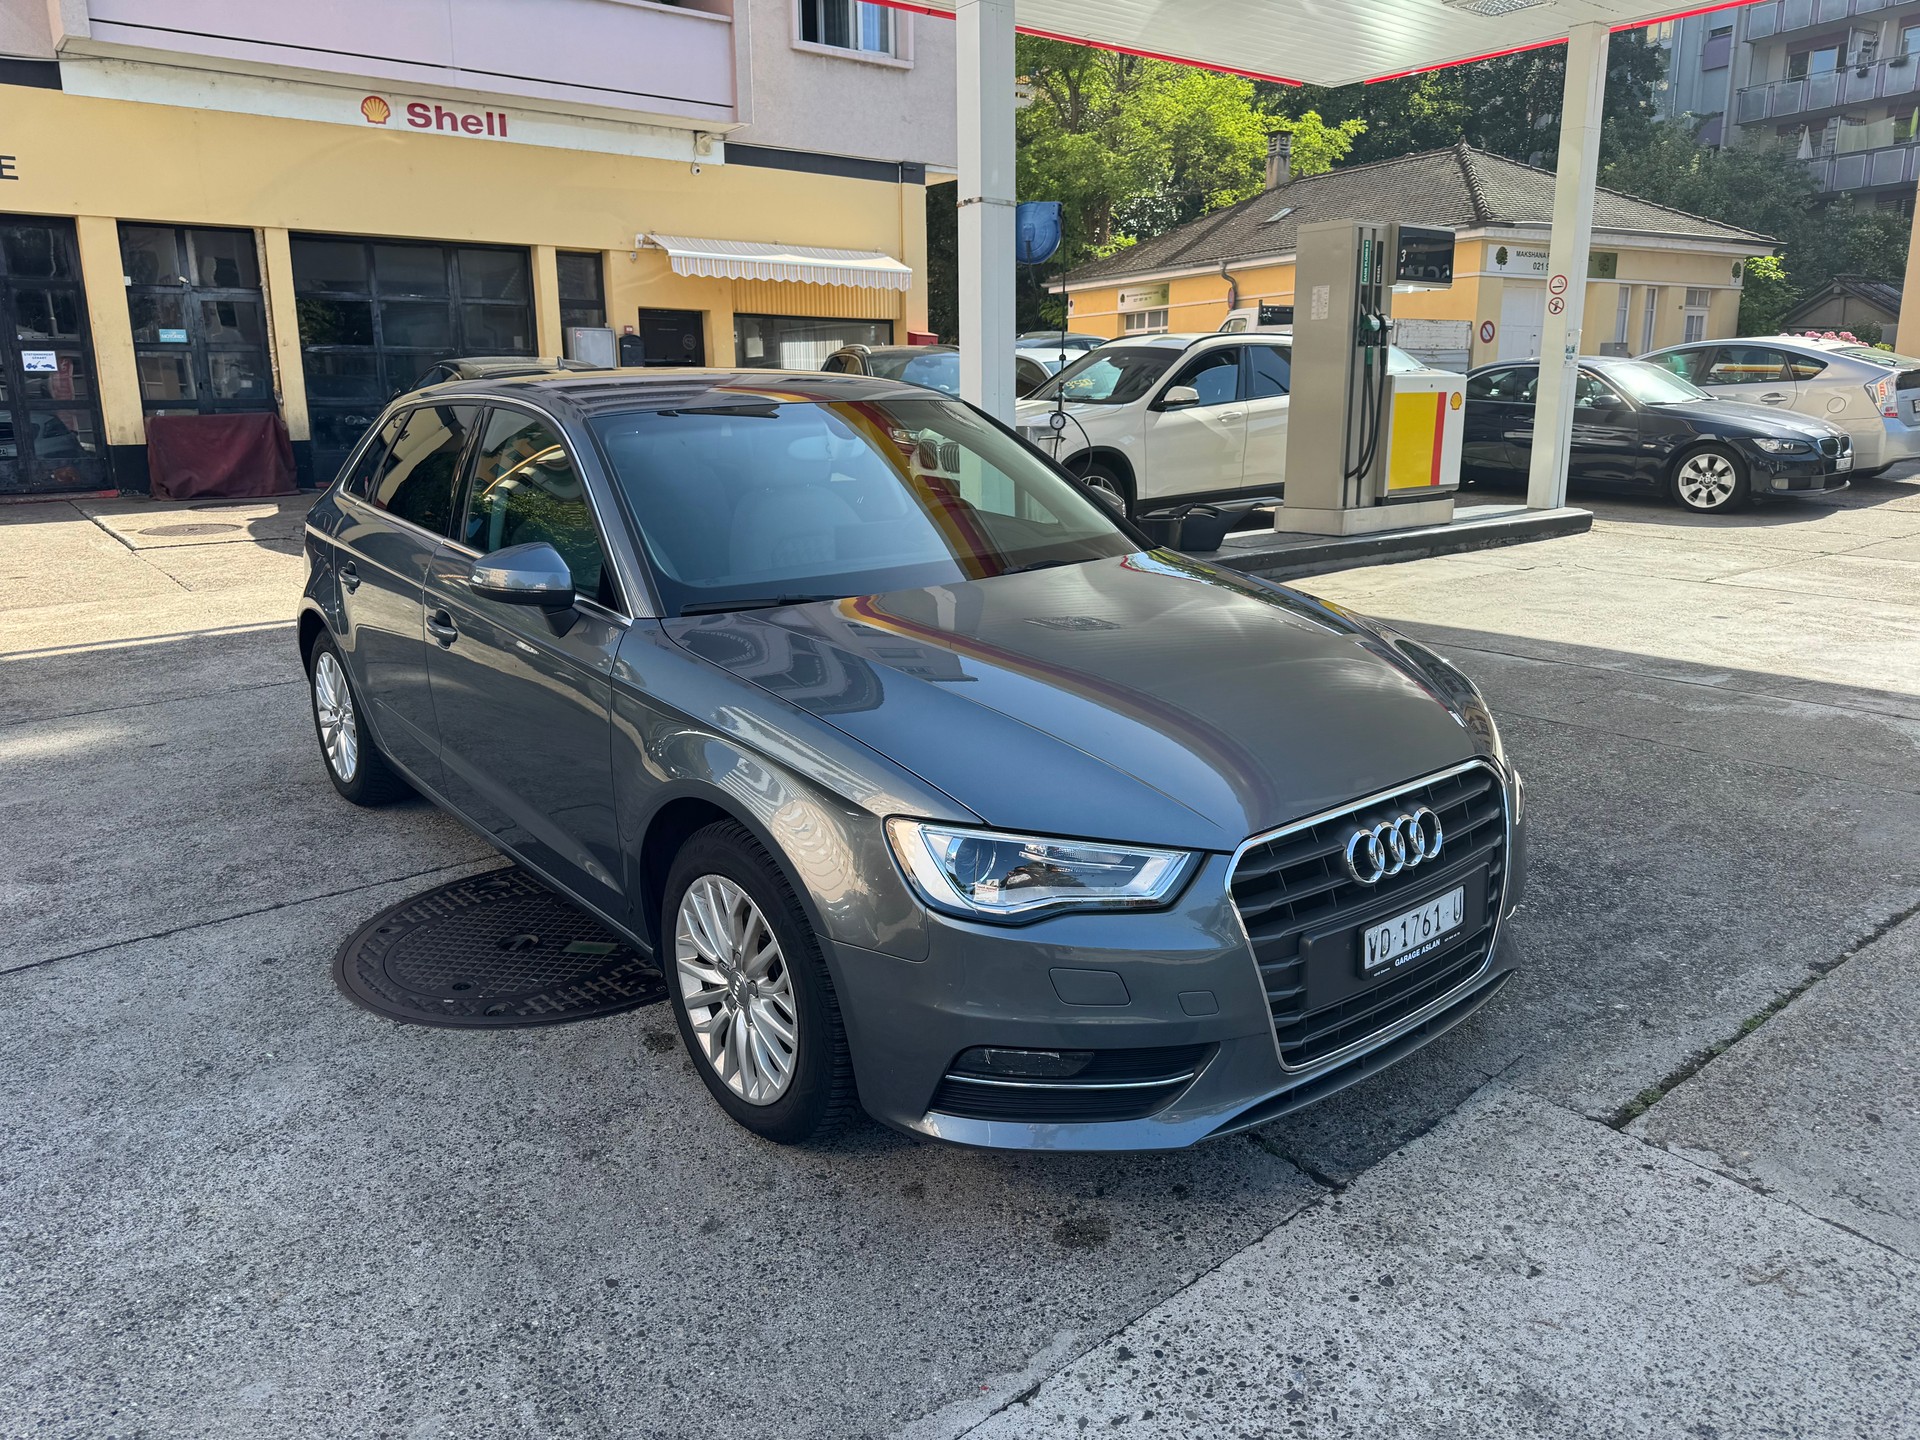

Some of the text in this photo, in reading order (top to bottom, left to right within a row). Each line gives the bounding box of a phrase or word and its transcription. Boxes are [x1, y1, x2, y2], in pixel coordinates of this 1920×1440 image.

[406, 102, 508, 138] Shell
[1400, 249, 1407, 263] 3
[1516, 250, 1547, 259] MAKSHANA
[1532, 262, 1544, 271] 021
[1368, 889, 1463, 963] VD 1761 U
[1394, 938, 1441, 967] GARAGE ASLAN
